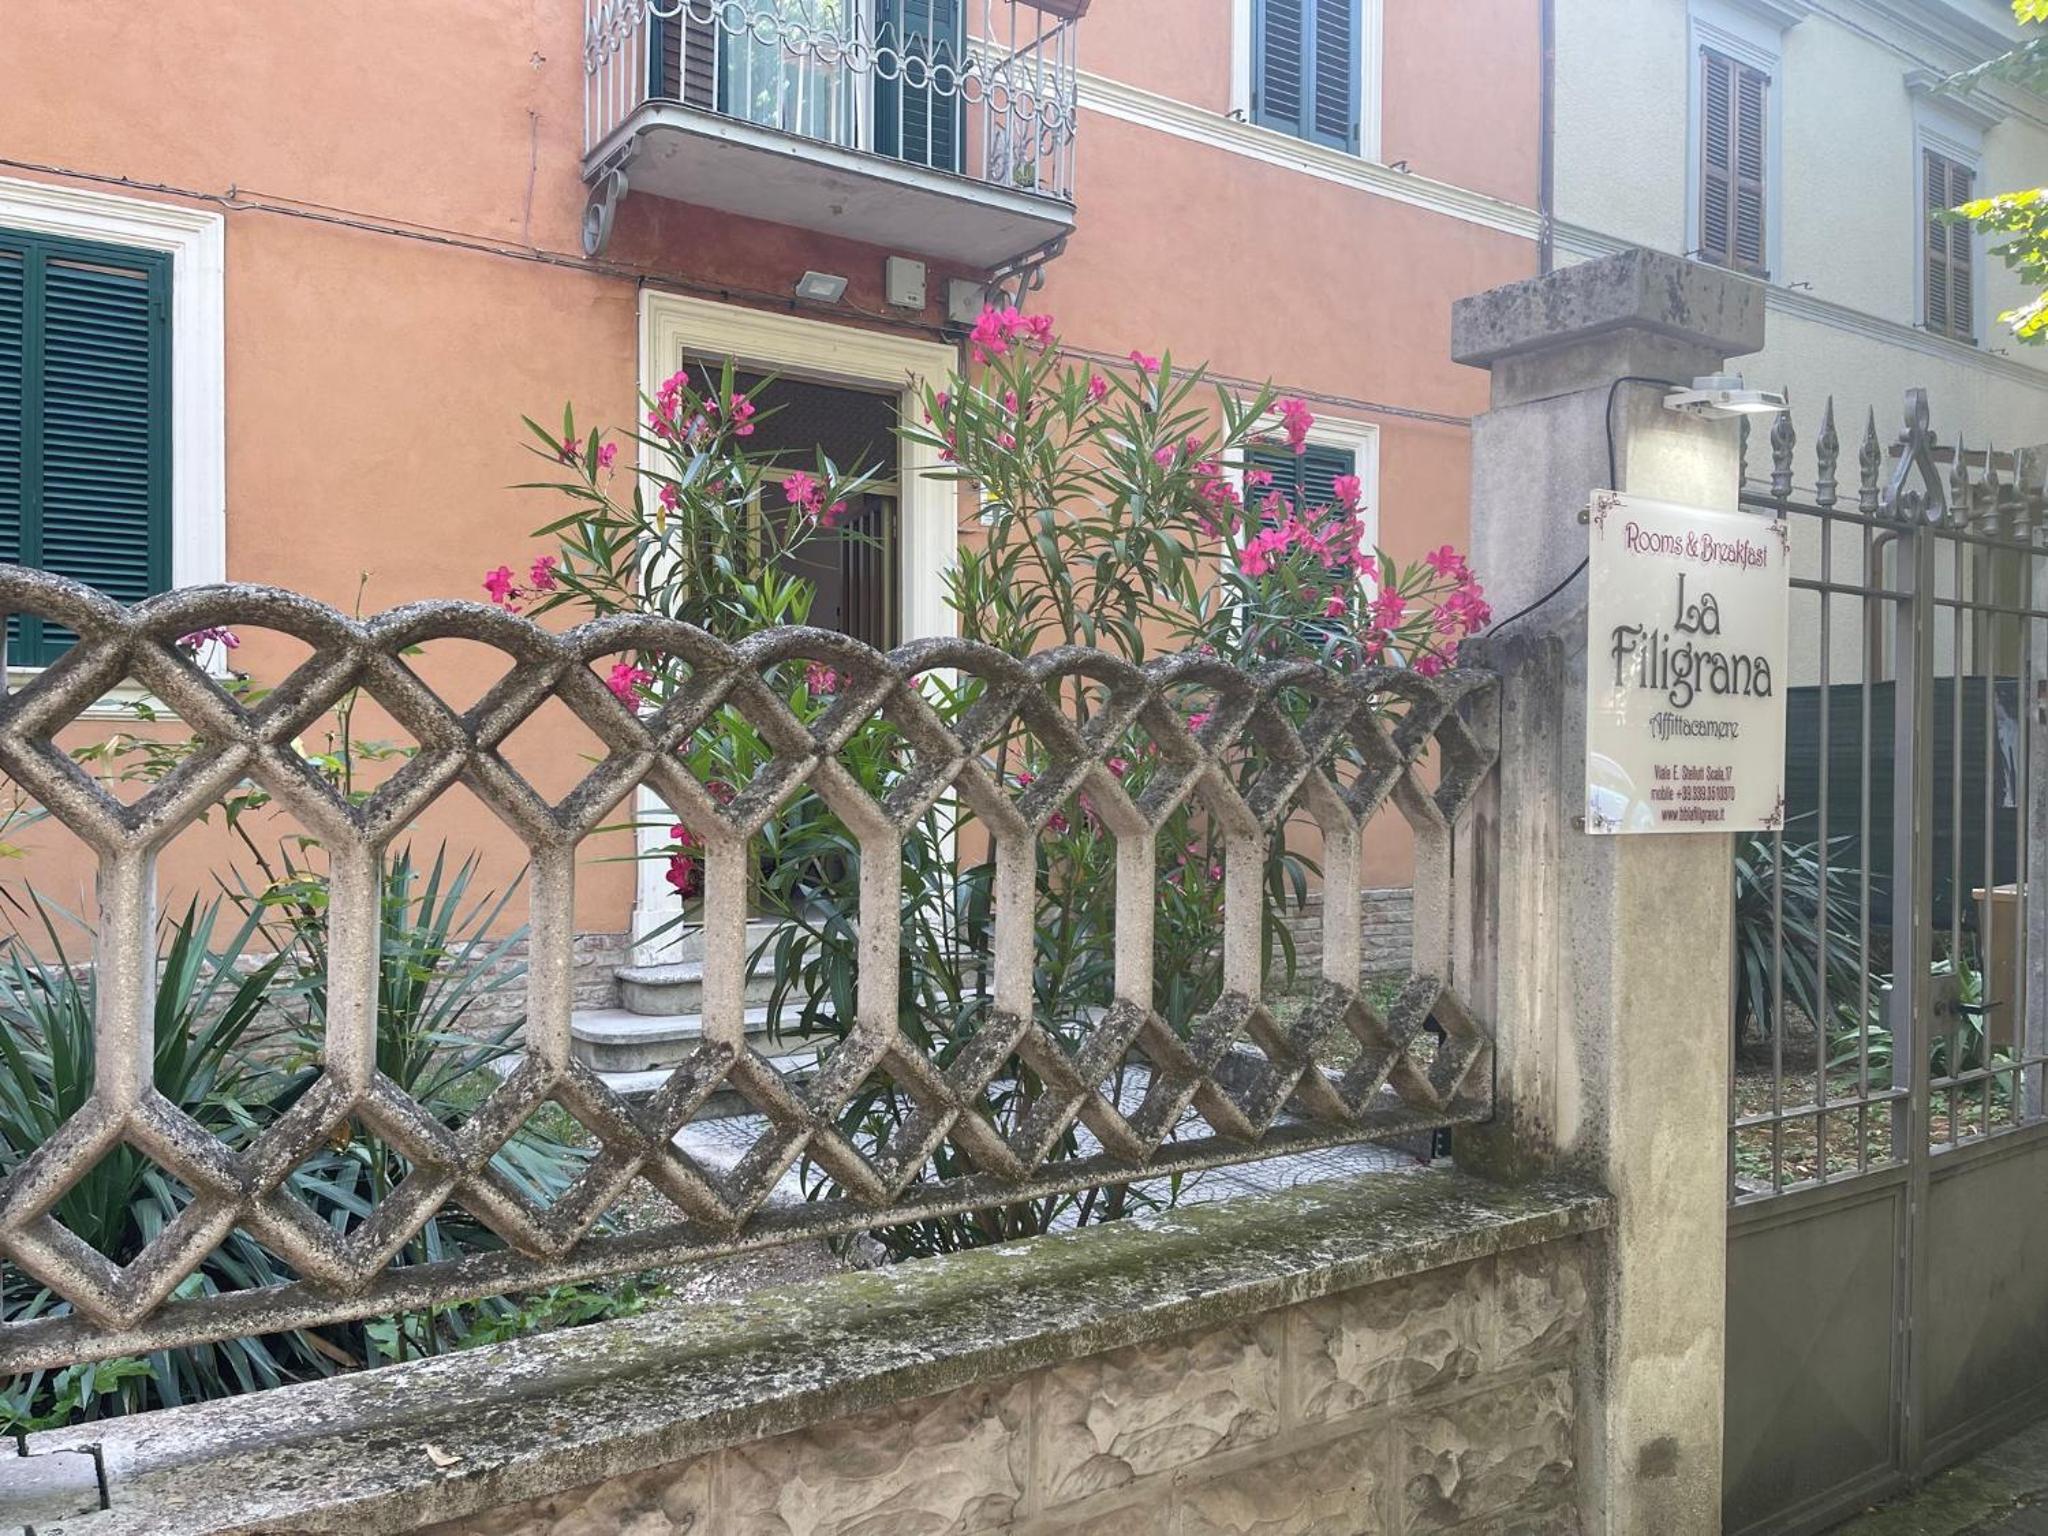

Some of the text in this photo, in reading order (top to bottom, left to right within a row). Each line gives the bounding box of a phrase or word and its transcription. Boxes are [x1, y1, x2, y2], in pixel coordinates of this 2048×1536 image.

[1625, 522, 1768, 570] Rooms & Breakfast
[1674, 573, 1720, 635] La
[1612, 623, 1773, 709] Filigrana
[1649, 712, 1739, 741] Affittacamere
[1654, 764, 1671, 780] Viale
[1651, 785, 1673, 801] mobile
